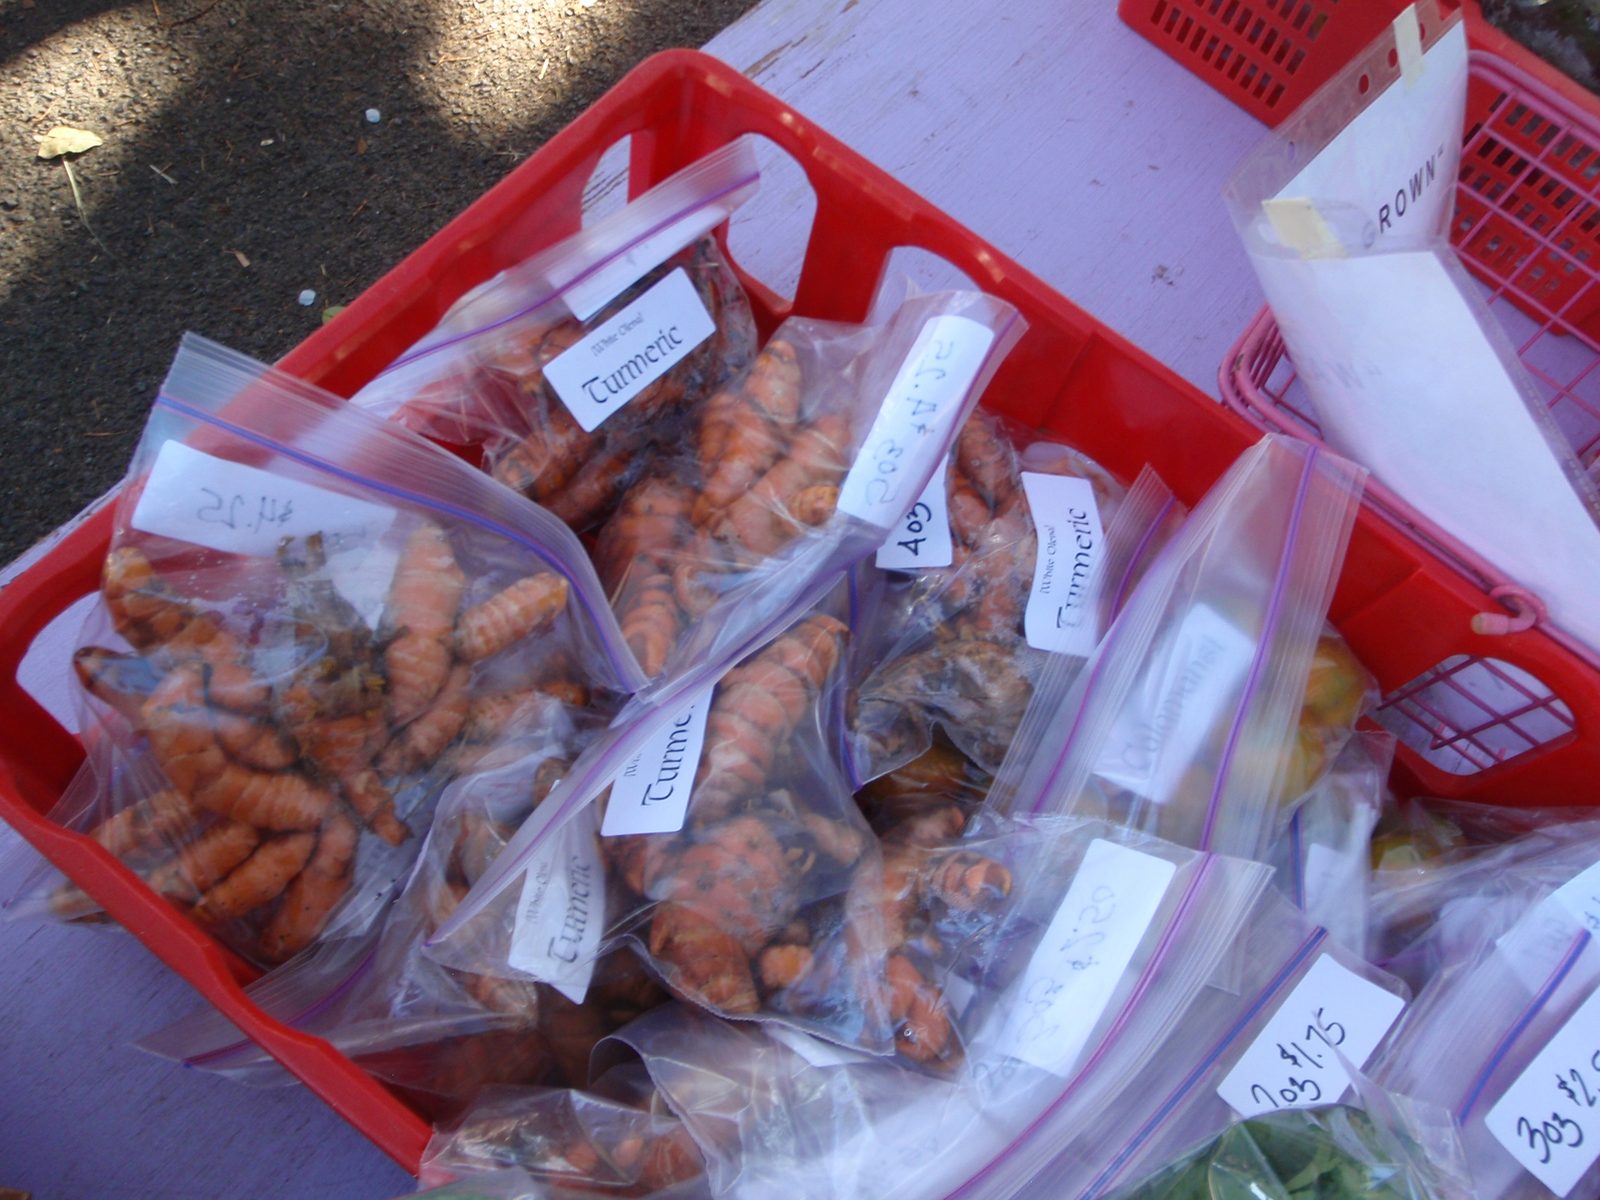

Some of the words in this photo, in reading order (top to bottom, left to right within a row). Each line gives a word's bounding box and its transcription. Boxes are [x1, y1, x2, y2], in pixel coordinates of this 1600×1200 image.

[581, 326, 682, 404] Turmeric
[1056, 508, 1092, 628] Turmeric
[547, 856, 591, 964] Turmeric
[1276, 1007, 1346, 1069] $1.75
[1517, 1112, 1583, 1164] 3oz
